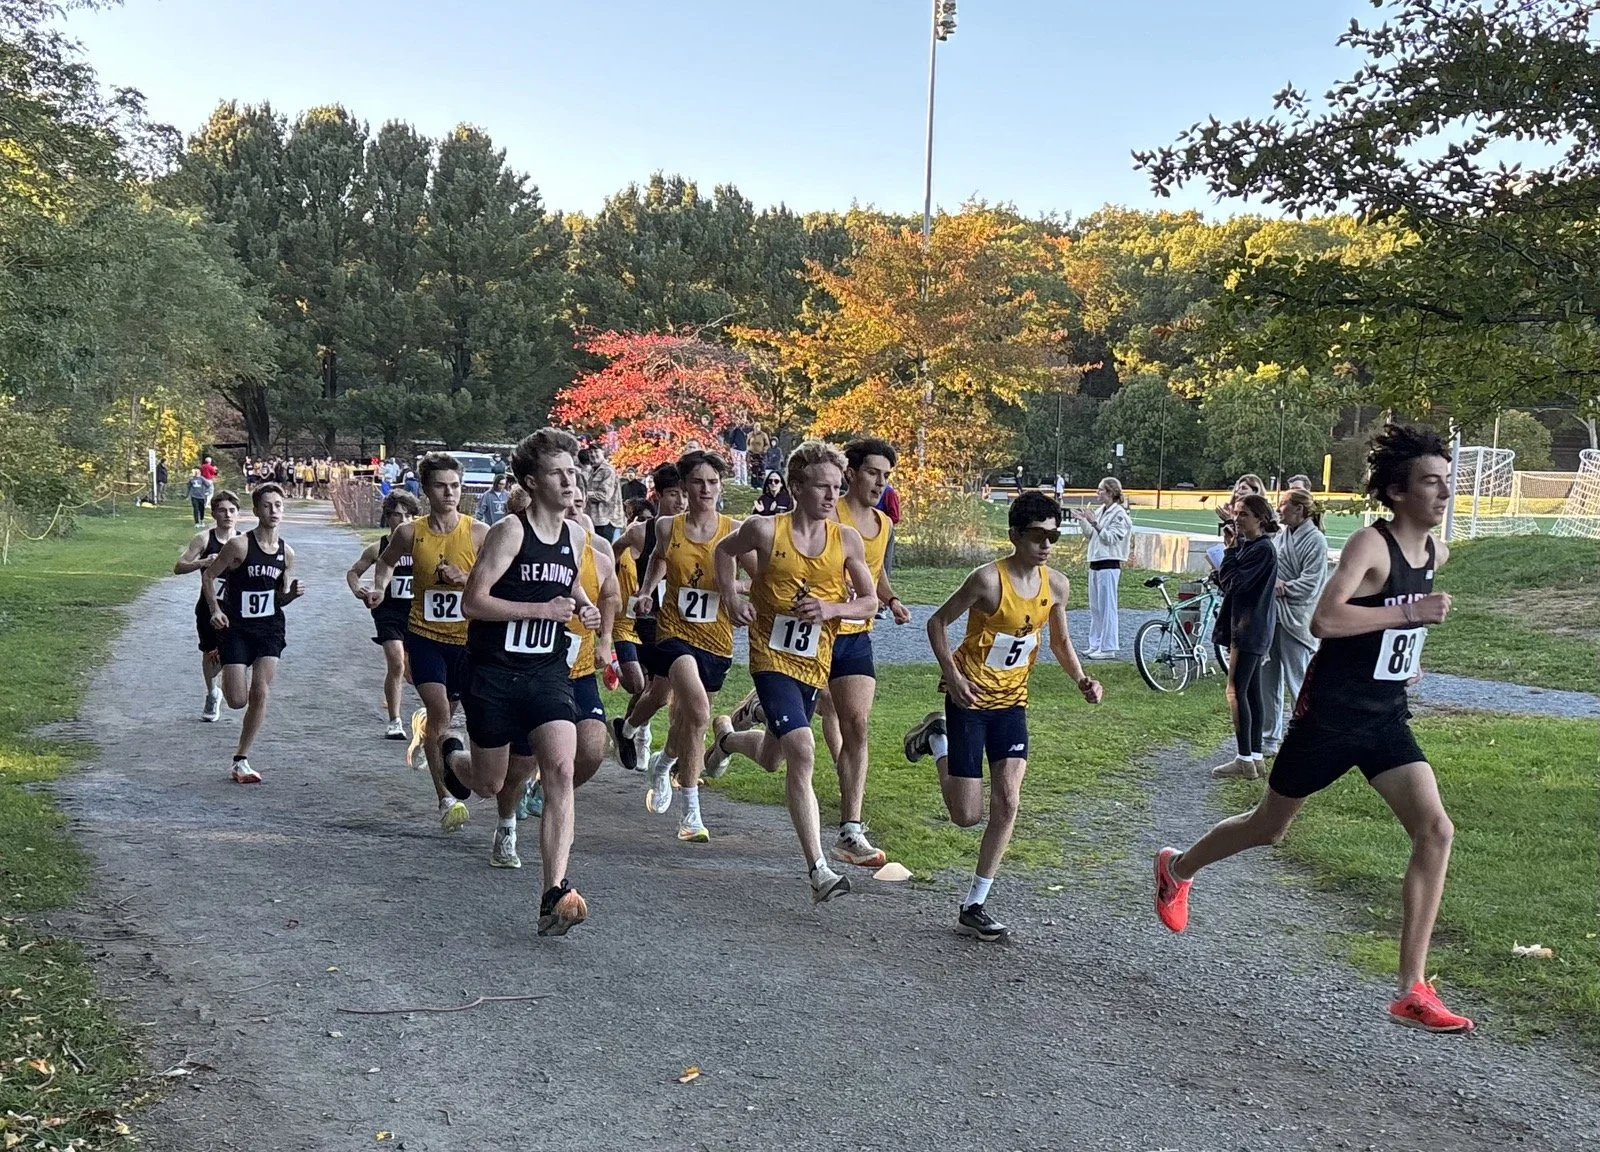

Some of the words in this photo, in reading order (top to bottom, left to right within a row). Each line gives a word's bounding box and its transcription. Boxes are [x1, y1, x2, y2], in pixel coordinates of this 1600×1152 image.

[396, 578, 413, 596] 74
[519, 562, 574, 587] READING
[248, 593, 270, 615] 97
[432, 592, 458, 618] 32
[685, 591, 709, 619] 21
[512, 618, 553, 649] 100
[783, 619, 813, 652] 13
[1004, 639, 1026, 667] 5
[1387, 632, 1417, 675] 83
